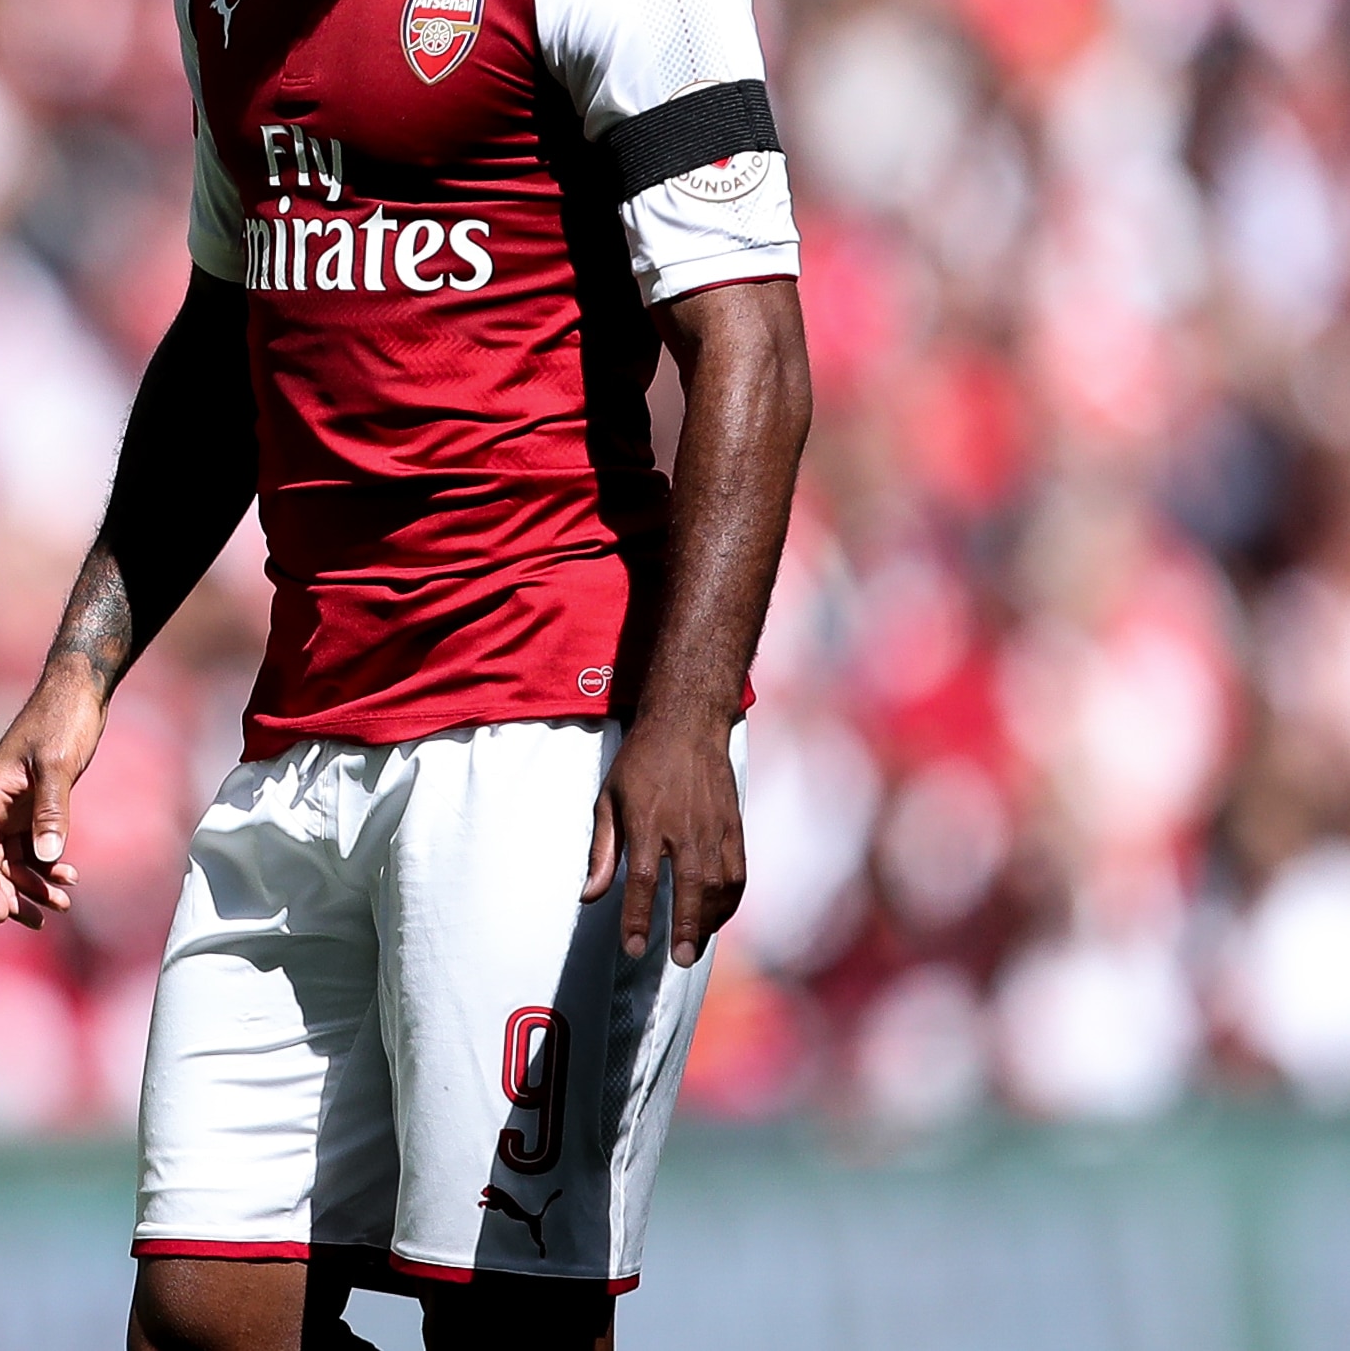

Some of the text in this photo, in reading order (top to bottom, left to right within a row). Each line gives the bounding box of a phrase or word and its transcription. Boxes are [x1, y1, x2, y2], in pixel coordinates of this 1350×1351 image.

[260, 124, 342, 202] Fly
[678, 155, 763, 193] OUNDATIO
[244, 195, 493, 291] mirates
[499, 1007, 570, 1175] 9
